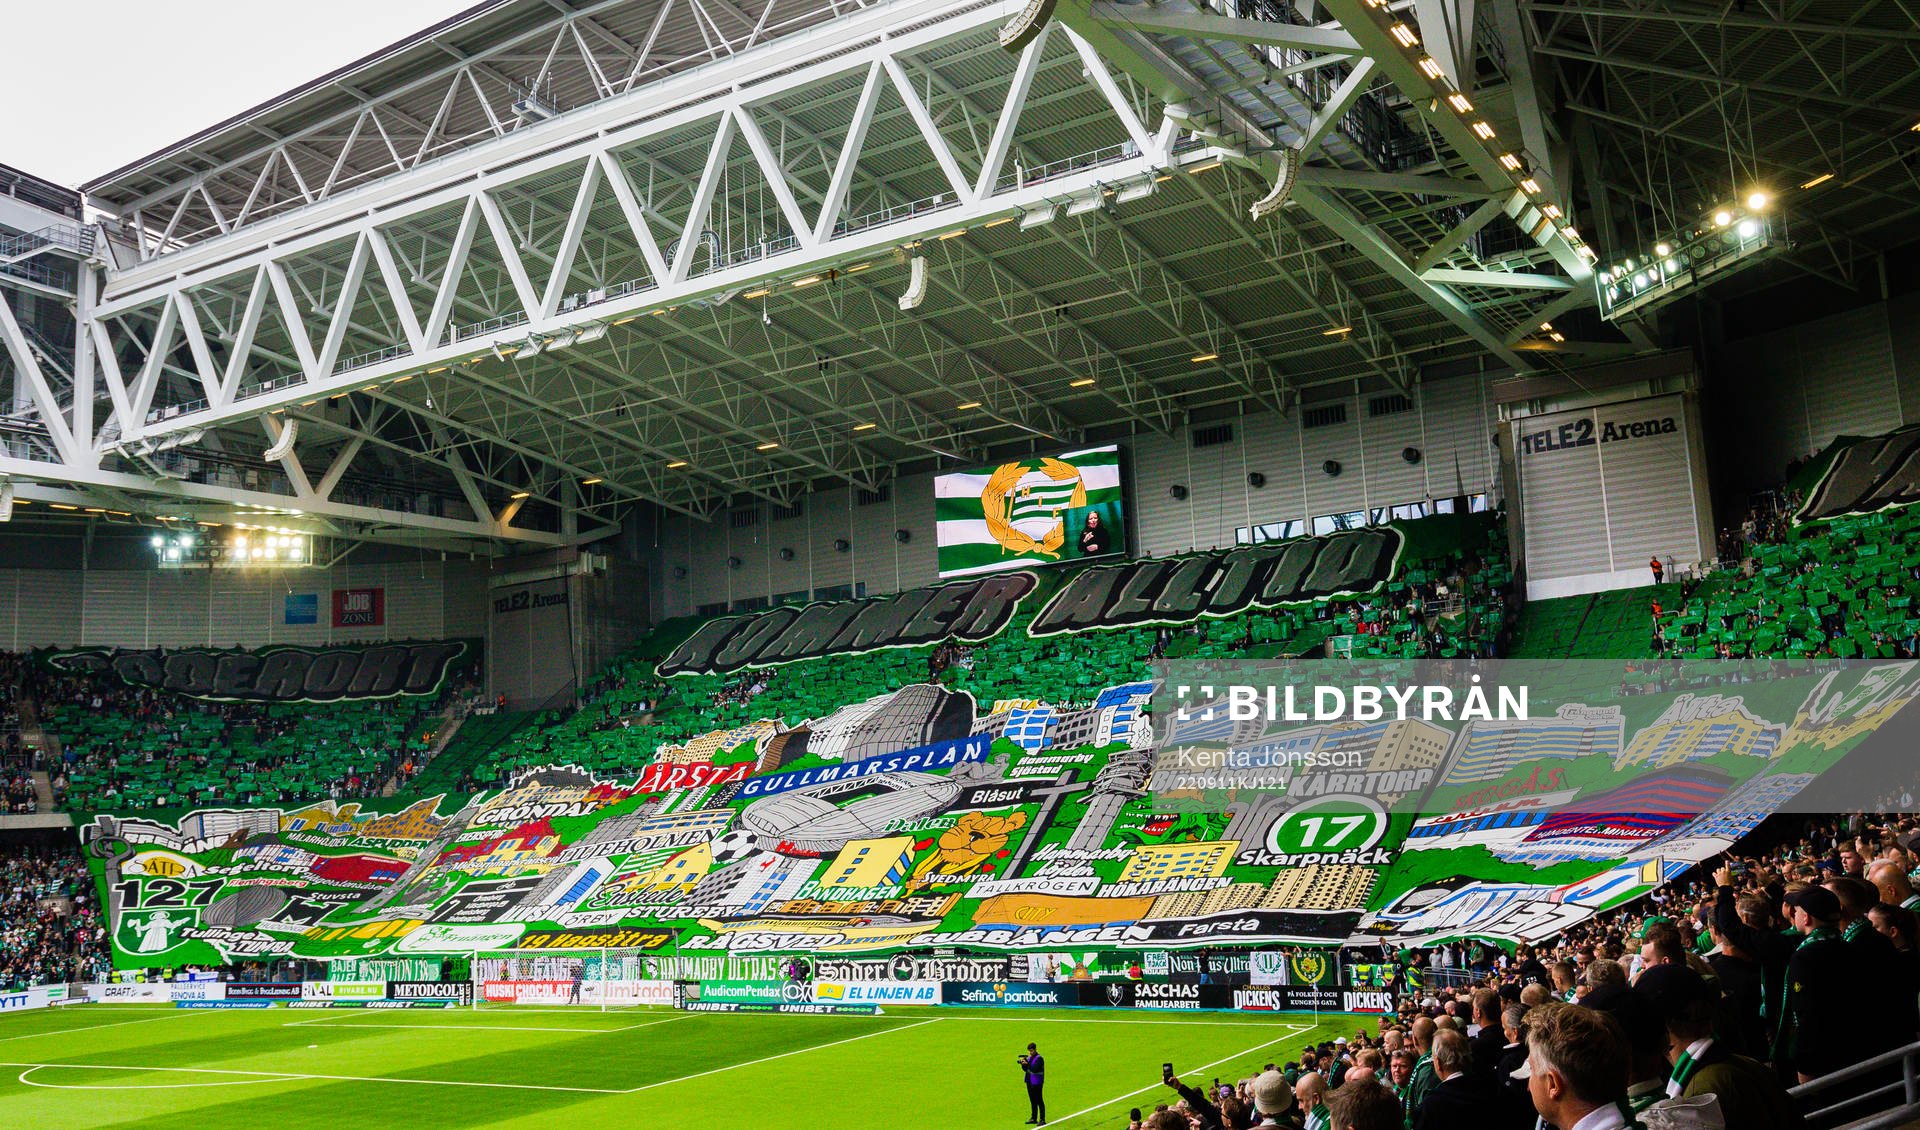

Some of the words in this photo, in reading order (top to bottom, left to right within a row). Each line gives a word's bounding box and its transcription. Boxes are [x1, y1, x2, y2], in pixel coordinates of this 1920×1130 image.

[1521, 418, 1596, 455] TELE2
[1600, 416, 1678, 443] Arena
[343, 592, 371, 612] JOB
[342, 613, 376, 624] ZONE
[743, 741, 982, 796] GULLMARSPLAN
[632, 763, 746, 796] ÅRSTA
[1287, 768, 1435, 797] KÄRRTORP
[970, 787, 1024, 804] Blåsut
[476, 801, 599, 825] GRÖNDAL
[1301, 815, 1367, 846] 17
[350, 836, 432, 850] ASPUDDEN
[558, 827, 722, 864] LILJEHOLMEN
[1237, 847, 1392, 868] Skarpnäck
[128, 857, 199, 878] SÄTRA
[203, 860, 311, 878] Segeltorp
[921, 872, 996, 884] SVEDMYRA
[1098, 875, 1234, 898] HÖKARÄNGEN
[113, 878, 227, 909] 127
[310, 892, 362, 900] Stuvsta
[590, 883, 686, 907] Enskede
[794, 881, 902, 901] BANDHAGEN
[564, 911, 618, 926] ÖRBY
[626, 906, 744, 919] STUREBY
[1015, 906, 1057, 921] CITY
[909, 924, 1159, 947] GUBBÄNGEN
[1178, 917, 1261, 938] Farsta
[232, 939, 296, 954] TUMBA
[518, 934, 548, 949] 19
[548, 930, 669, 949] Hagsätra
[680, 931, 846, 950] RÅGSVED
[728, 957, 777, 981] ULTRAS
[817, 957, 885, 981] Söder
[922, 958, 1006, 982] Bröder
[1169, 955, 1194, 973] Non
[105, 986, 132, 997] CRAFT
[486, 984, 514, 998] HUSKI
[516, 984, 574, 999] CHOCOLAT
[703, 985, 781, 999] AudicomPendax
[849, 987, 864, 999] EL
[867, 987, 913, 999] LINJEN
[915, 987, 935, 999] AB
[961, 989, 996, 1002] Sefina
[1004, 991, 1058, 1004] pantbank
[1135, 984, 1199, 998] SASCHAS
[1233, 990, 1280, 1010] DICKENS
[687, 1003, 739, 1011] UNIBET
[779, 1005, 836, 1013] UNIBET
[1135, 1000, 1200, 1009] FAMILJEARBETE
[1344, 991, 1393, 1012] DICKENS
